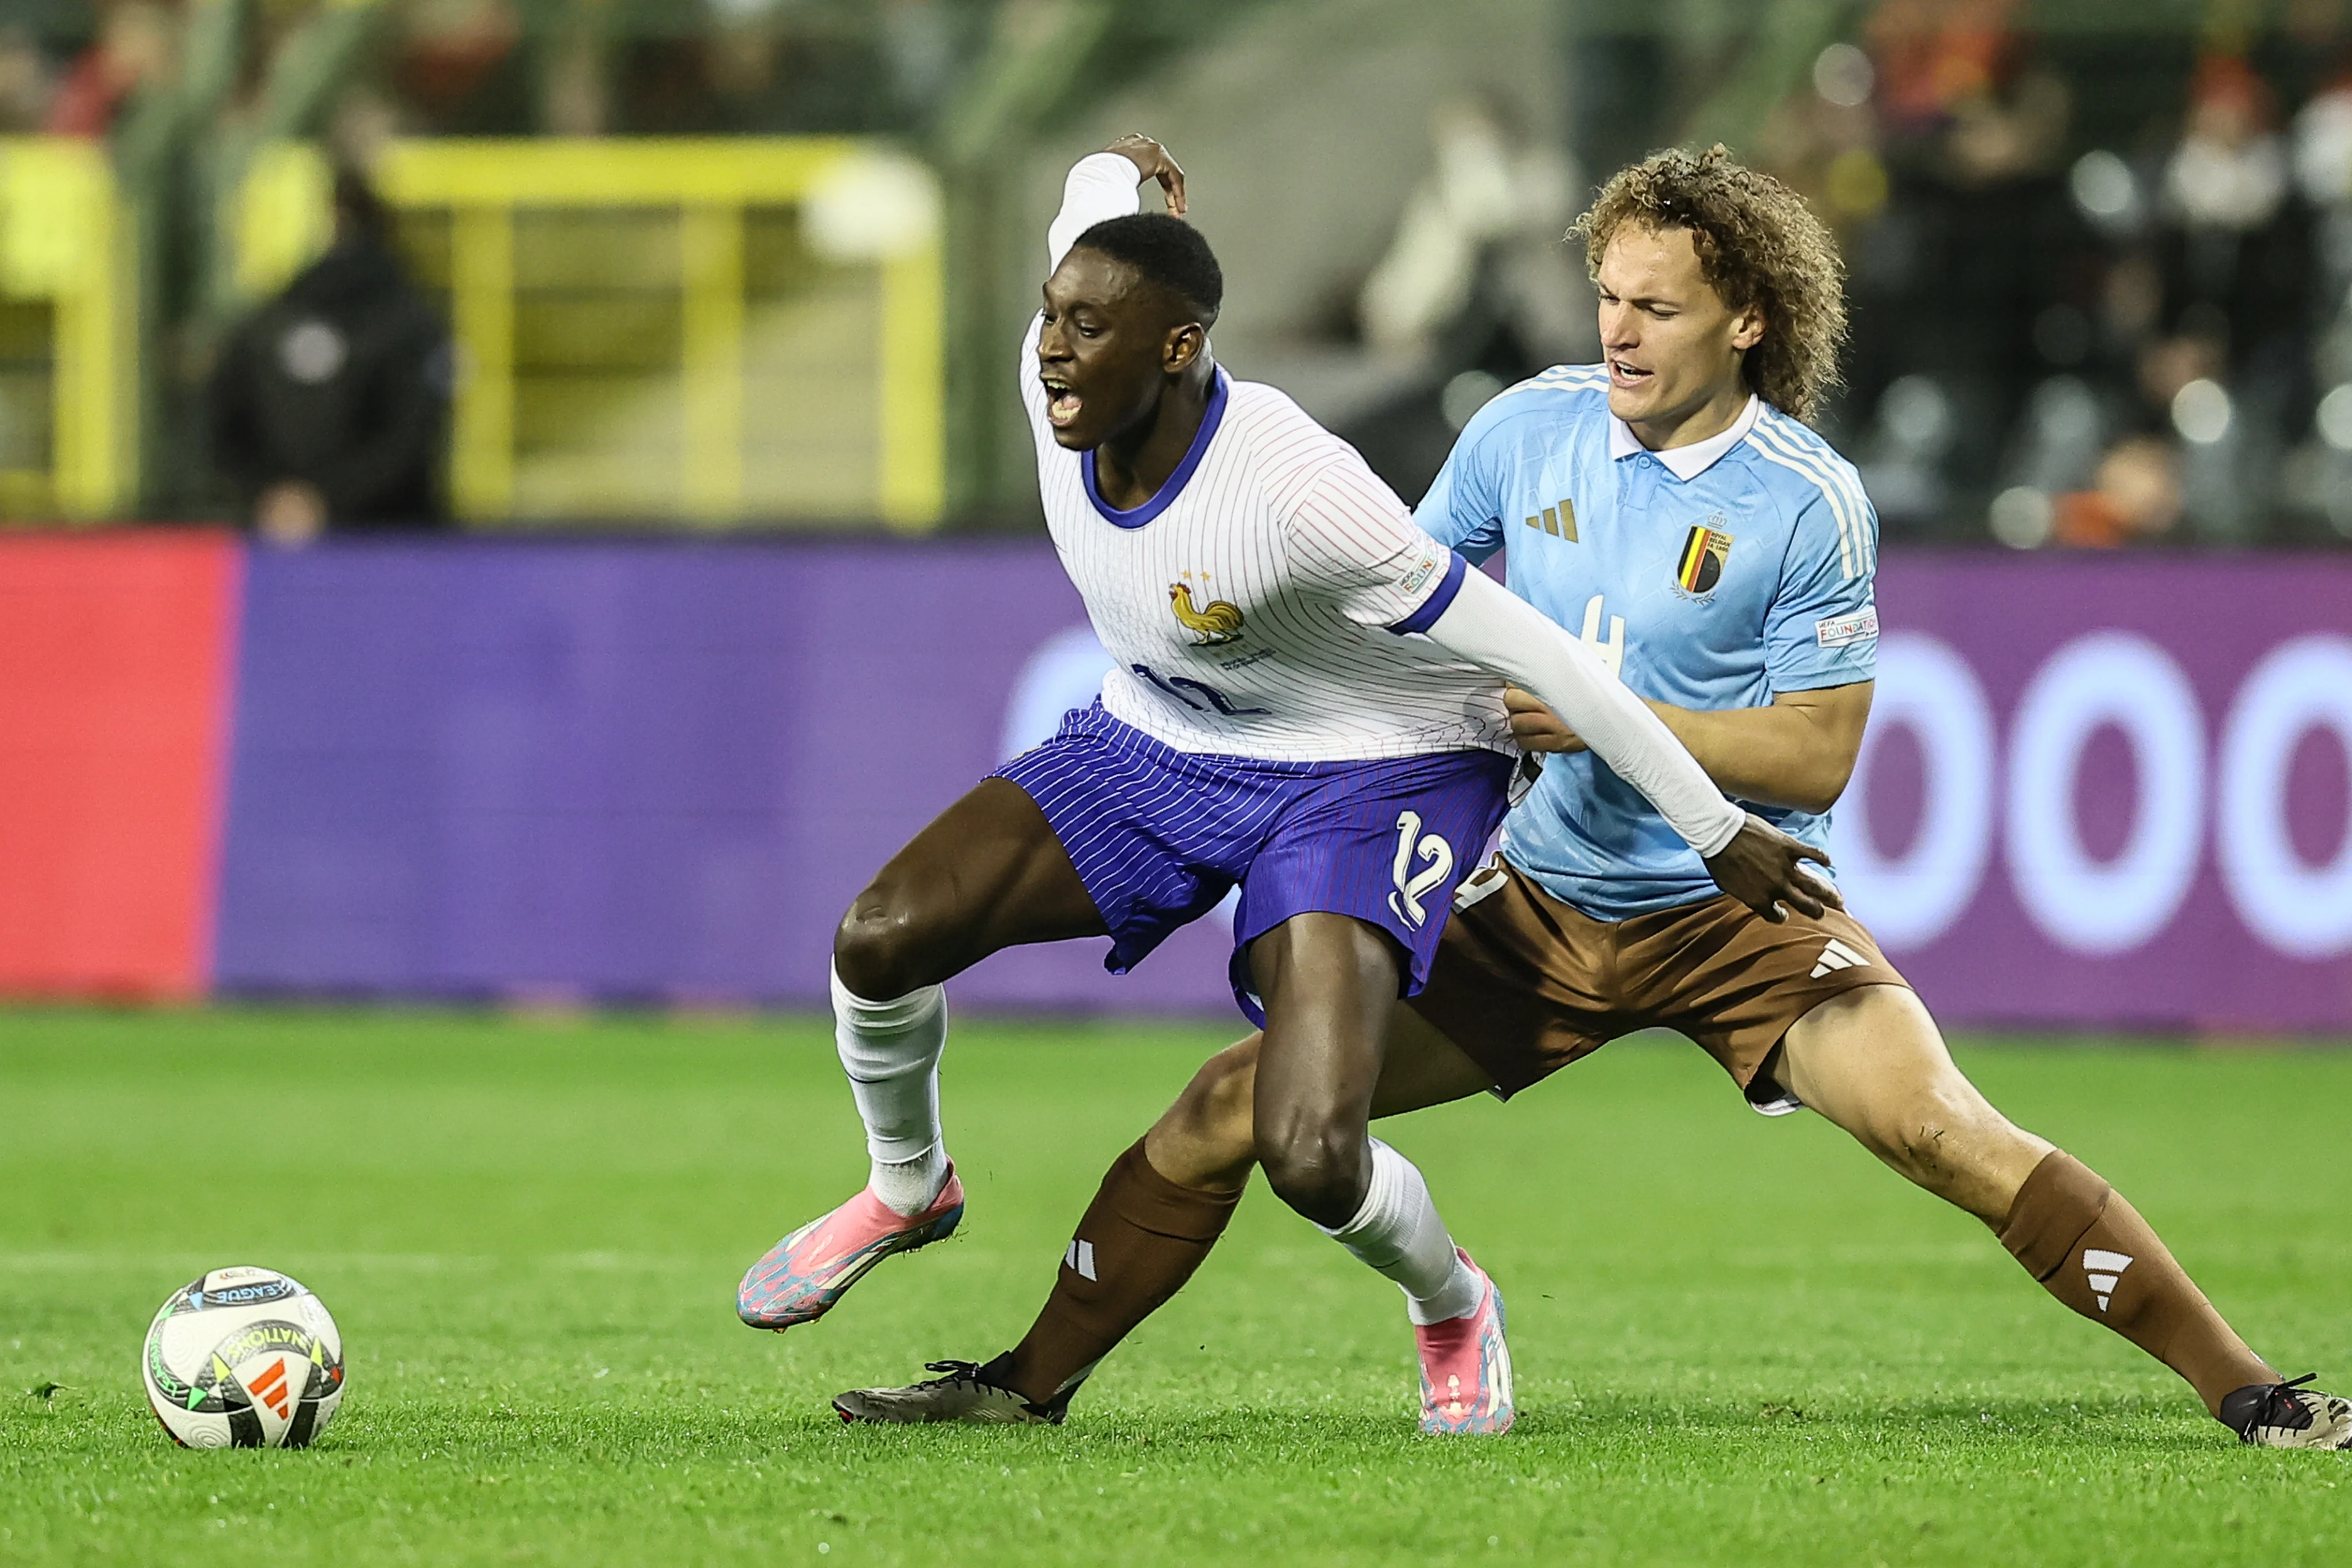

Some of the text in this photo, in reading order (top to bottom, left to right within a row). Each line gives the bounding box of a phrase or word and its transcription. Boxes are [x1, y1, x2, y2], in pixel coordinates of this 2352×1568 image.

[1579, 594, 1626, 679] 4
[1821, 617, 1875, 639] FOUNDATIO
[1388, 810, 1453, 932] 12
[216, 1283, 287, 1304] LEAGUE
[226, 1327, 309, 1359] NATIONS
